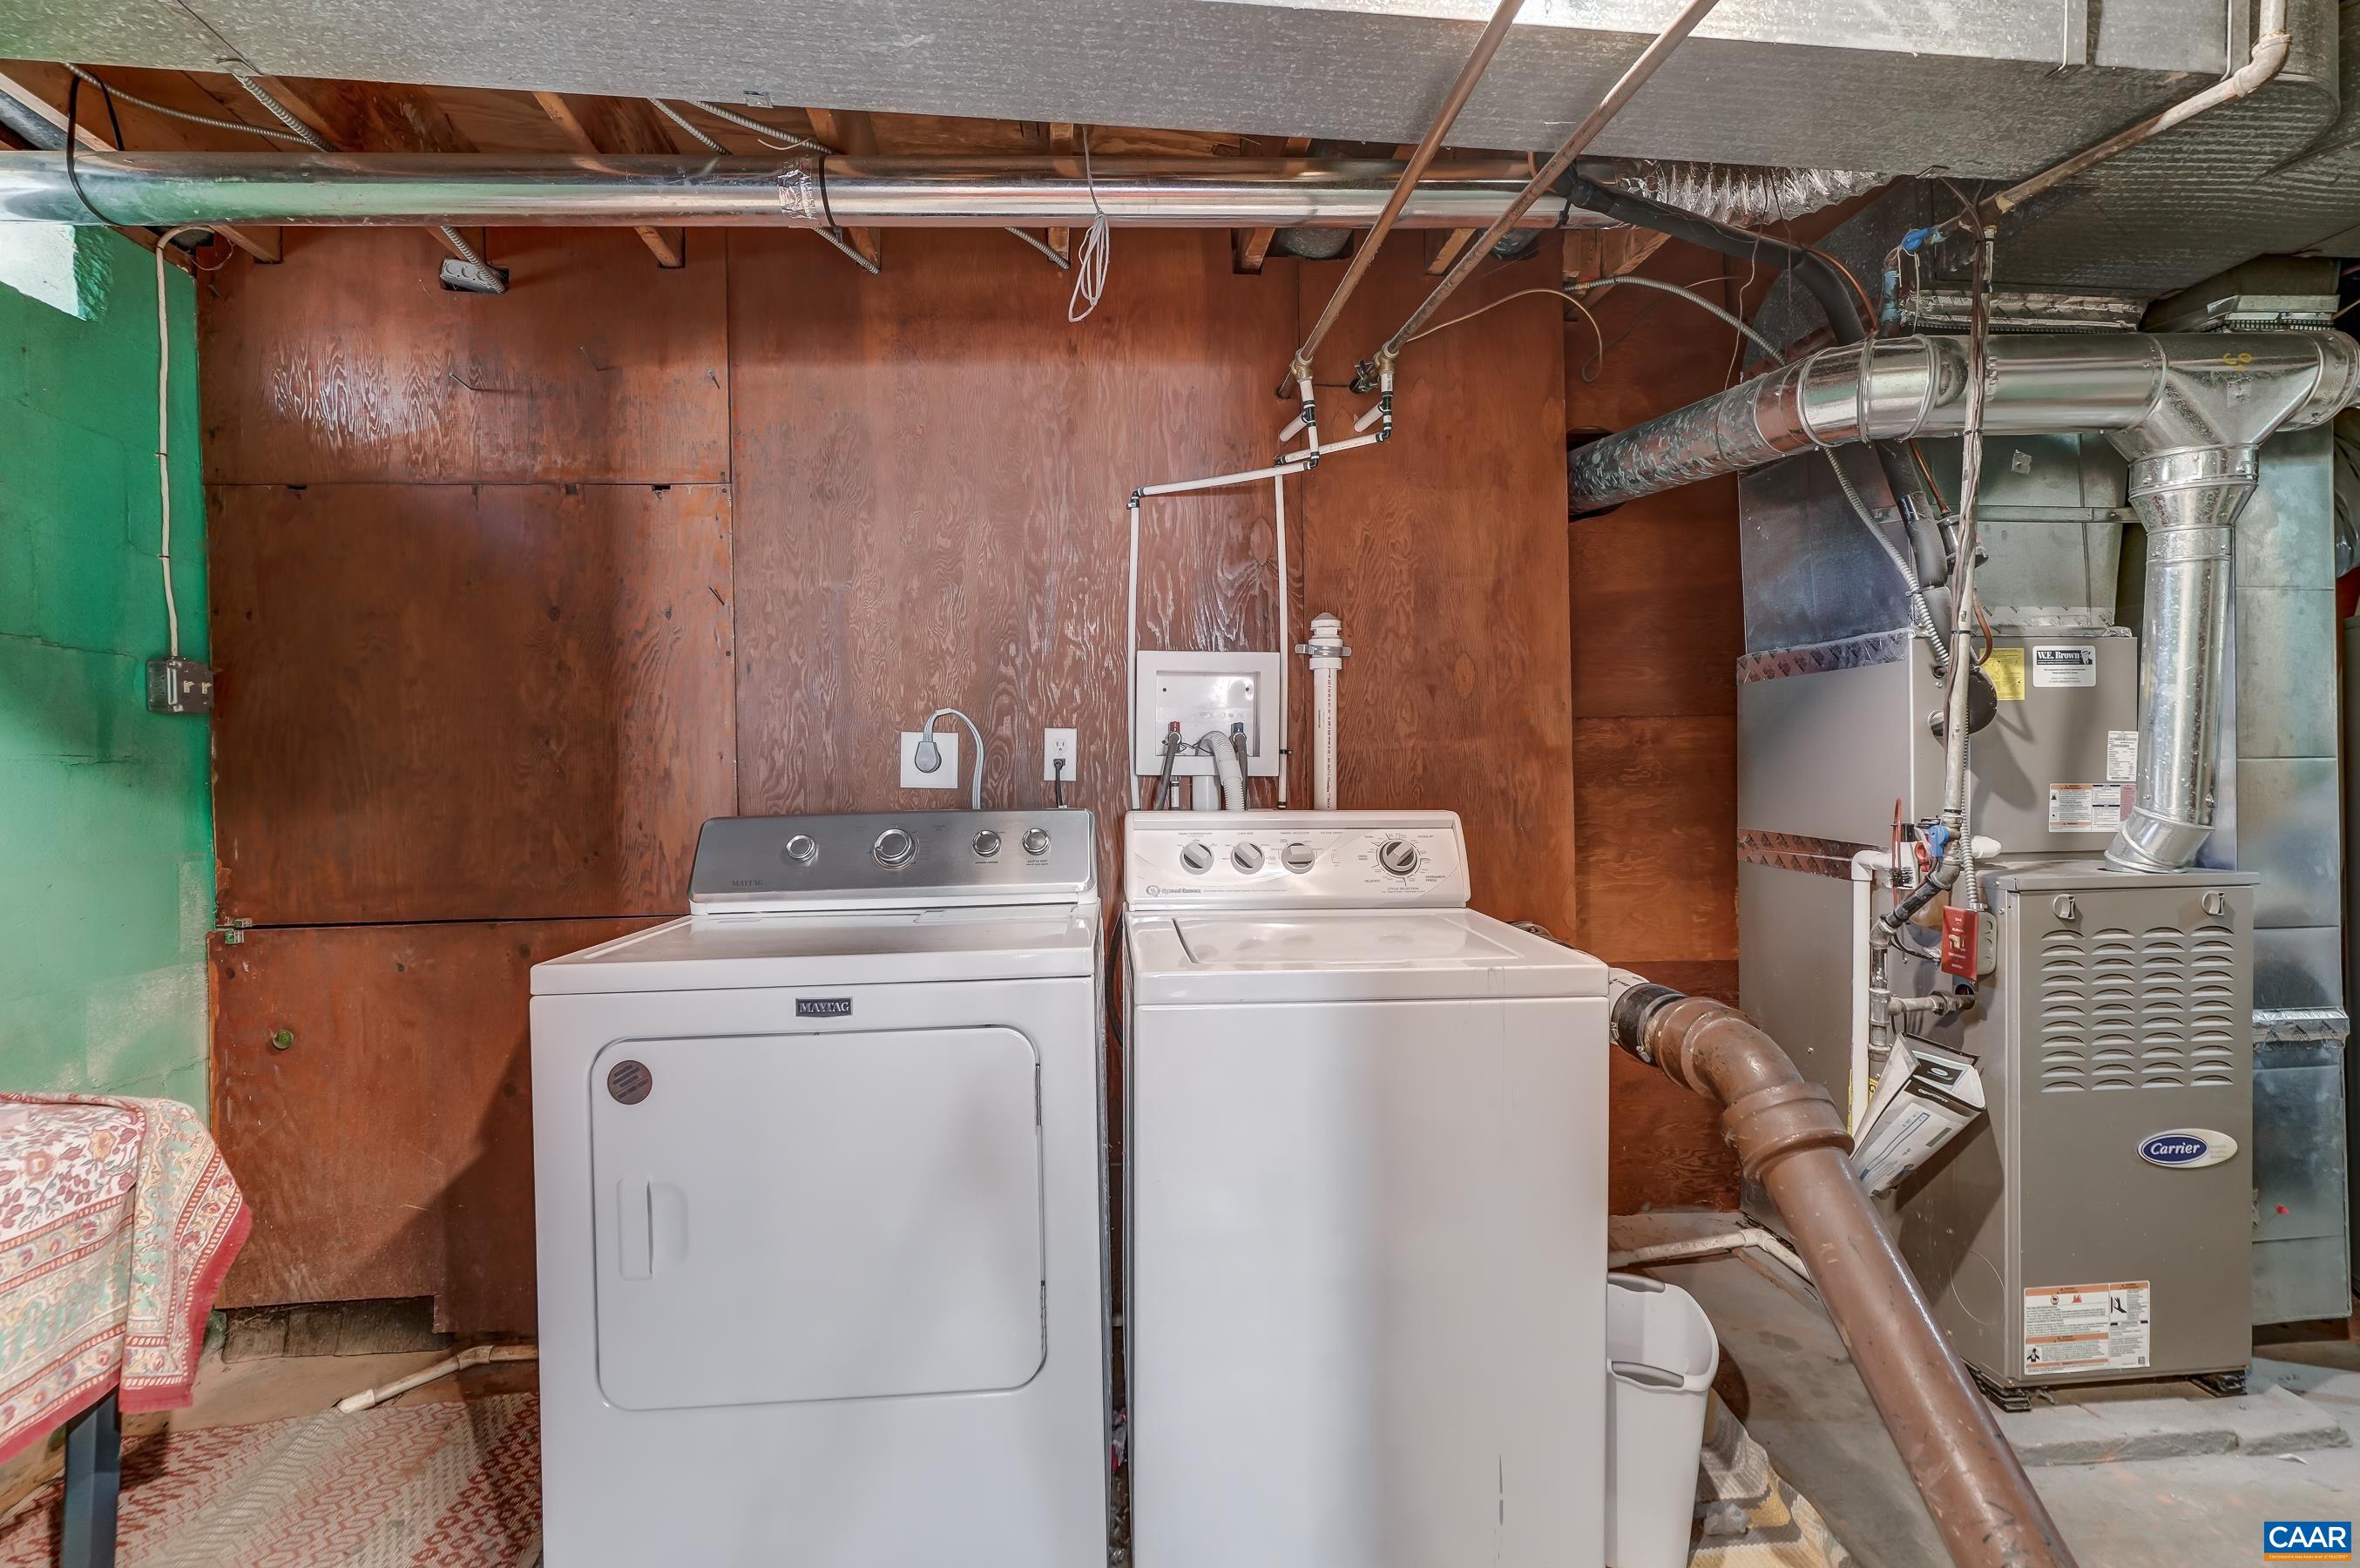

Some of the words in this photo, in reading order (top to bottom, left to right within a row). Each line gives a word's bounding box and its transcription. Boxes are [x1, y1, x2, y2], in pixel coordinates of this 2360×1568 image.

[2037, 651, 2054, 659] W.E.
[2055, 651, 2080, 659] Brown
[799, 1002, 849, 1013] MAYTAG
[2150, 1142, 2201, 1155] Carrier
